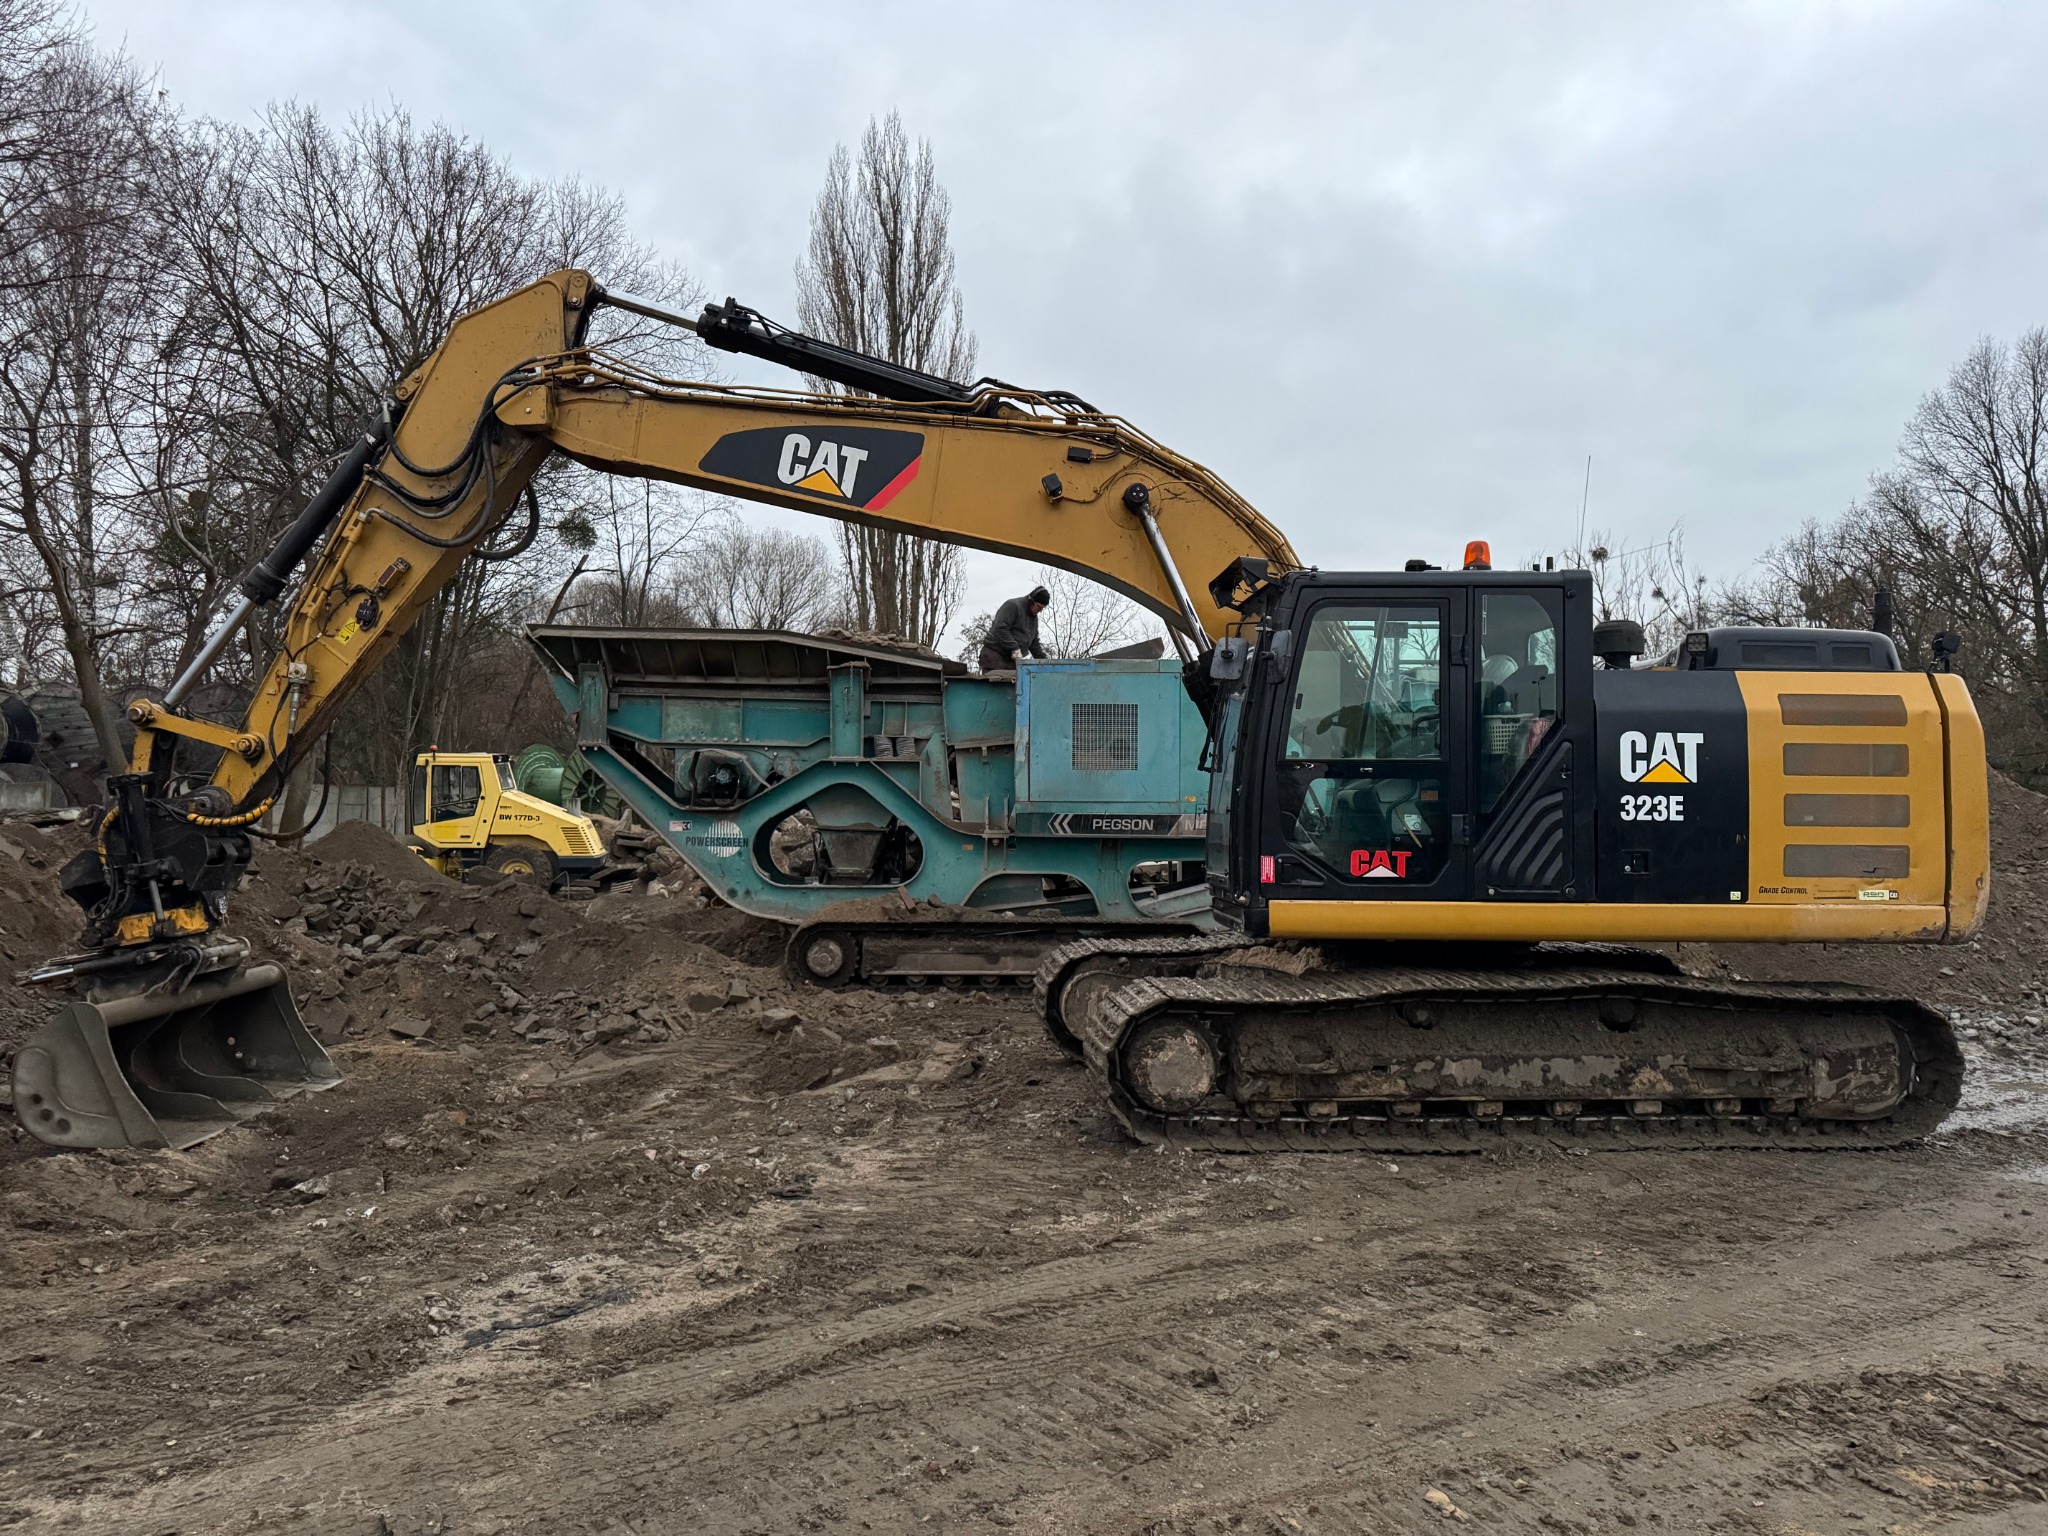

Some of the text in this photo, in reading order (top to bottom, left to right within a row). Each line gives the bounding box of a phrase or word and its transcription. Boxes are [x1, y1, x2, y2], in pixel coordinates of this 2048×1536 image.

[777, 433, 869, 499] CAT
[1619, 730, 1704, 783] CAT
[1620, 795, 1684, 821] 323E
[1092, 819, 1154, 831] PEGSON
[685, 836, 749, 848] POWERSCREEN
[1350, 849, 1412, 878] CAT
